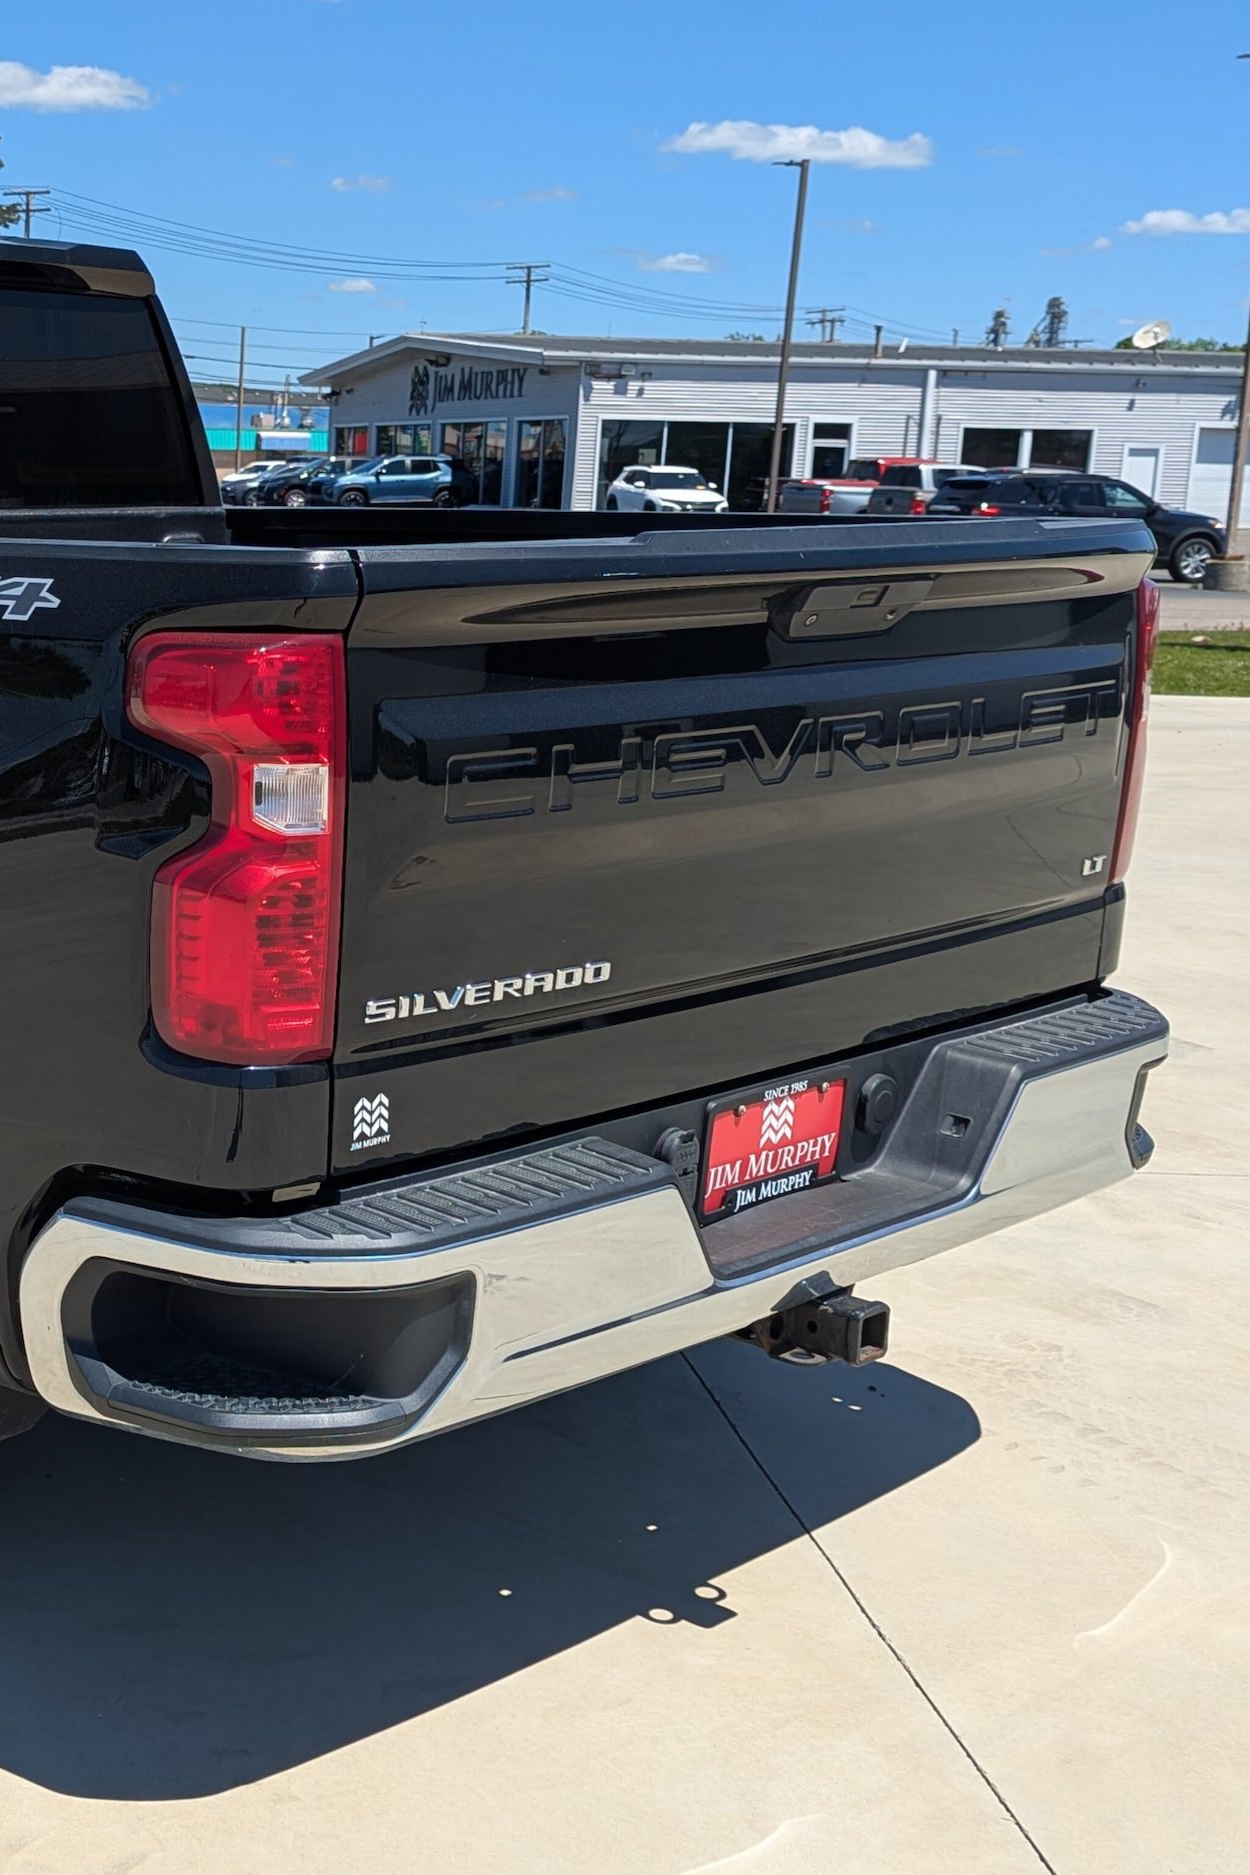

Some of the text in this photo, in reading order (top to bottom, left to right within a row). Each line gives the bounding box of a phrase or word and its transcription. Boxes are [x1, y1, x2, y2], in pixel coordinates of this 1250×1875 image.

[430, 366, 528, 413] JIM MURPHY
[444, 679, 1117, 824] CHEVROLET
[1081, 854, 1108, 876] LT
[364, 960, 612, 1024] SILVERADO
[763, 1079, 808, 1102] SINCE 1985
[363, 1134, 390, 1149] MURPHY
[705, 1132, 837, 1198] JIM MURPHY
[734, 1170, 813, 1213] JIM MURPHY
